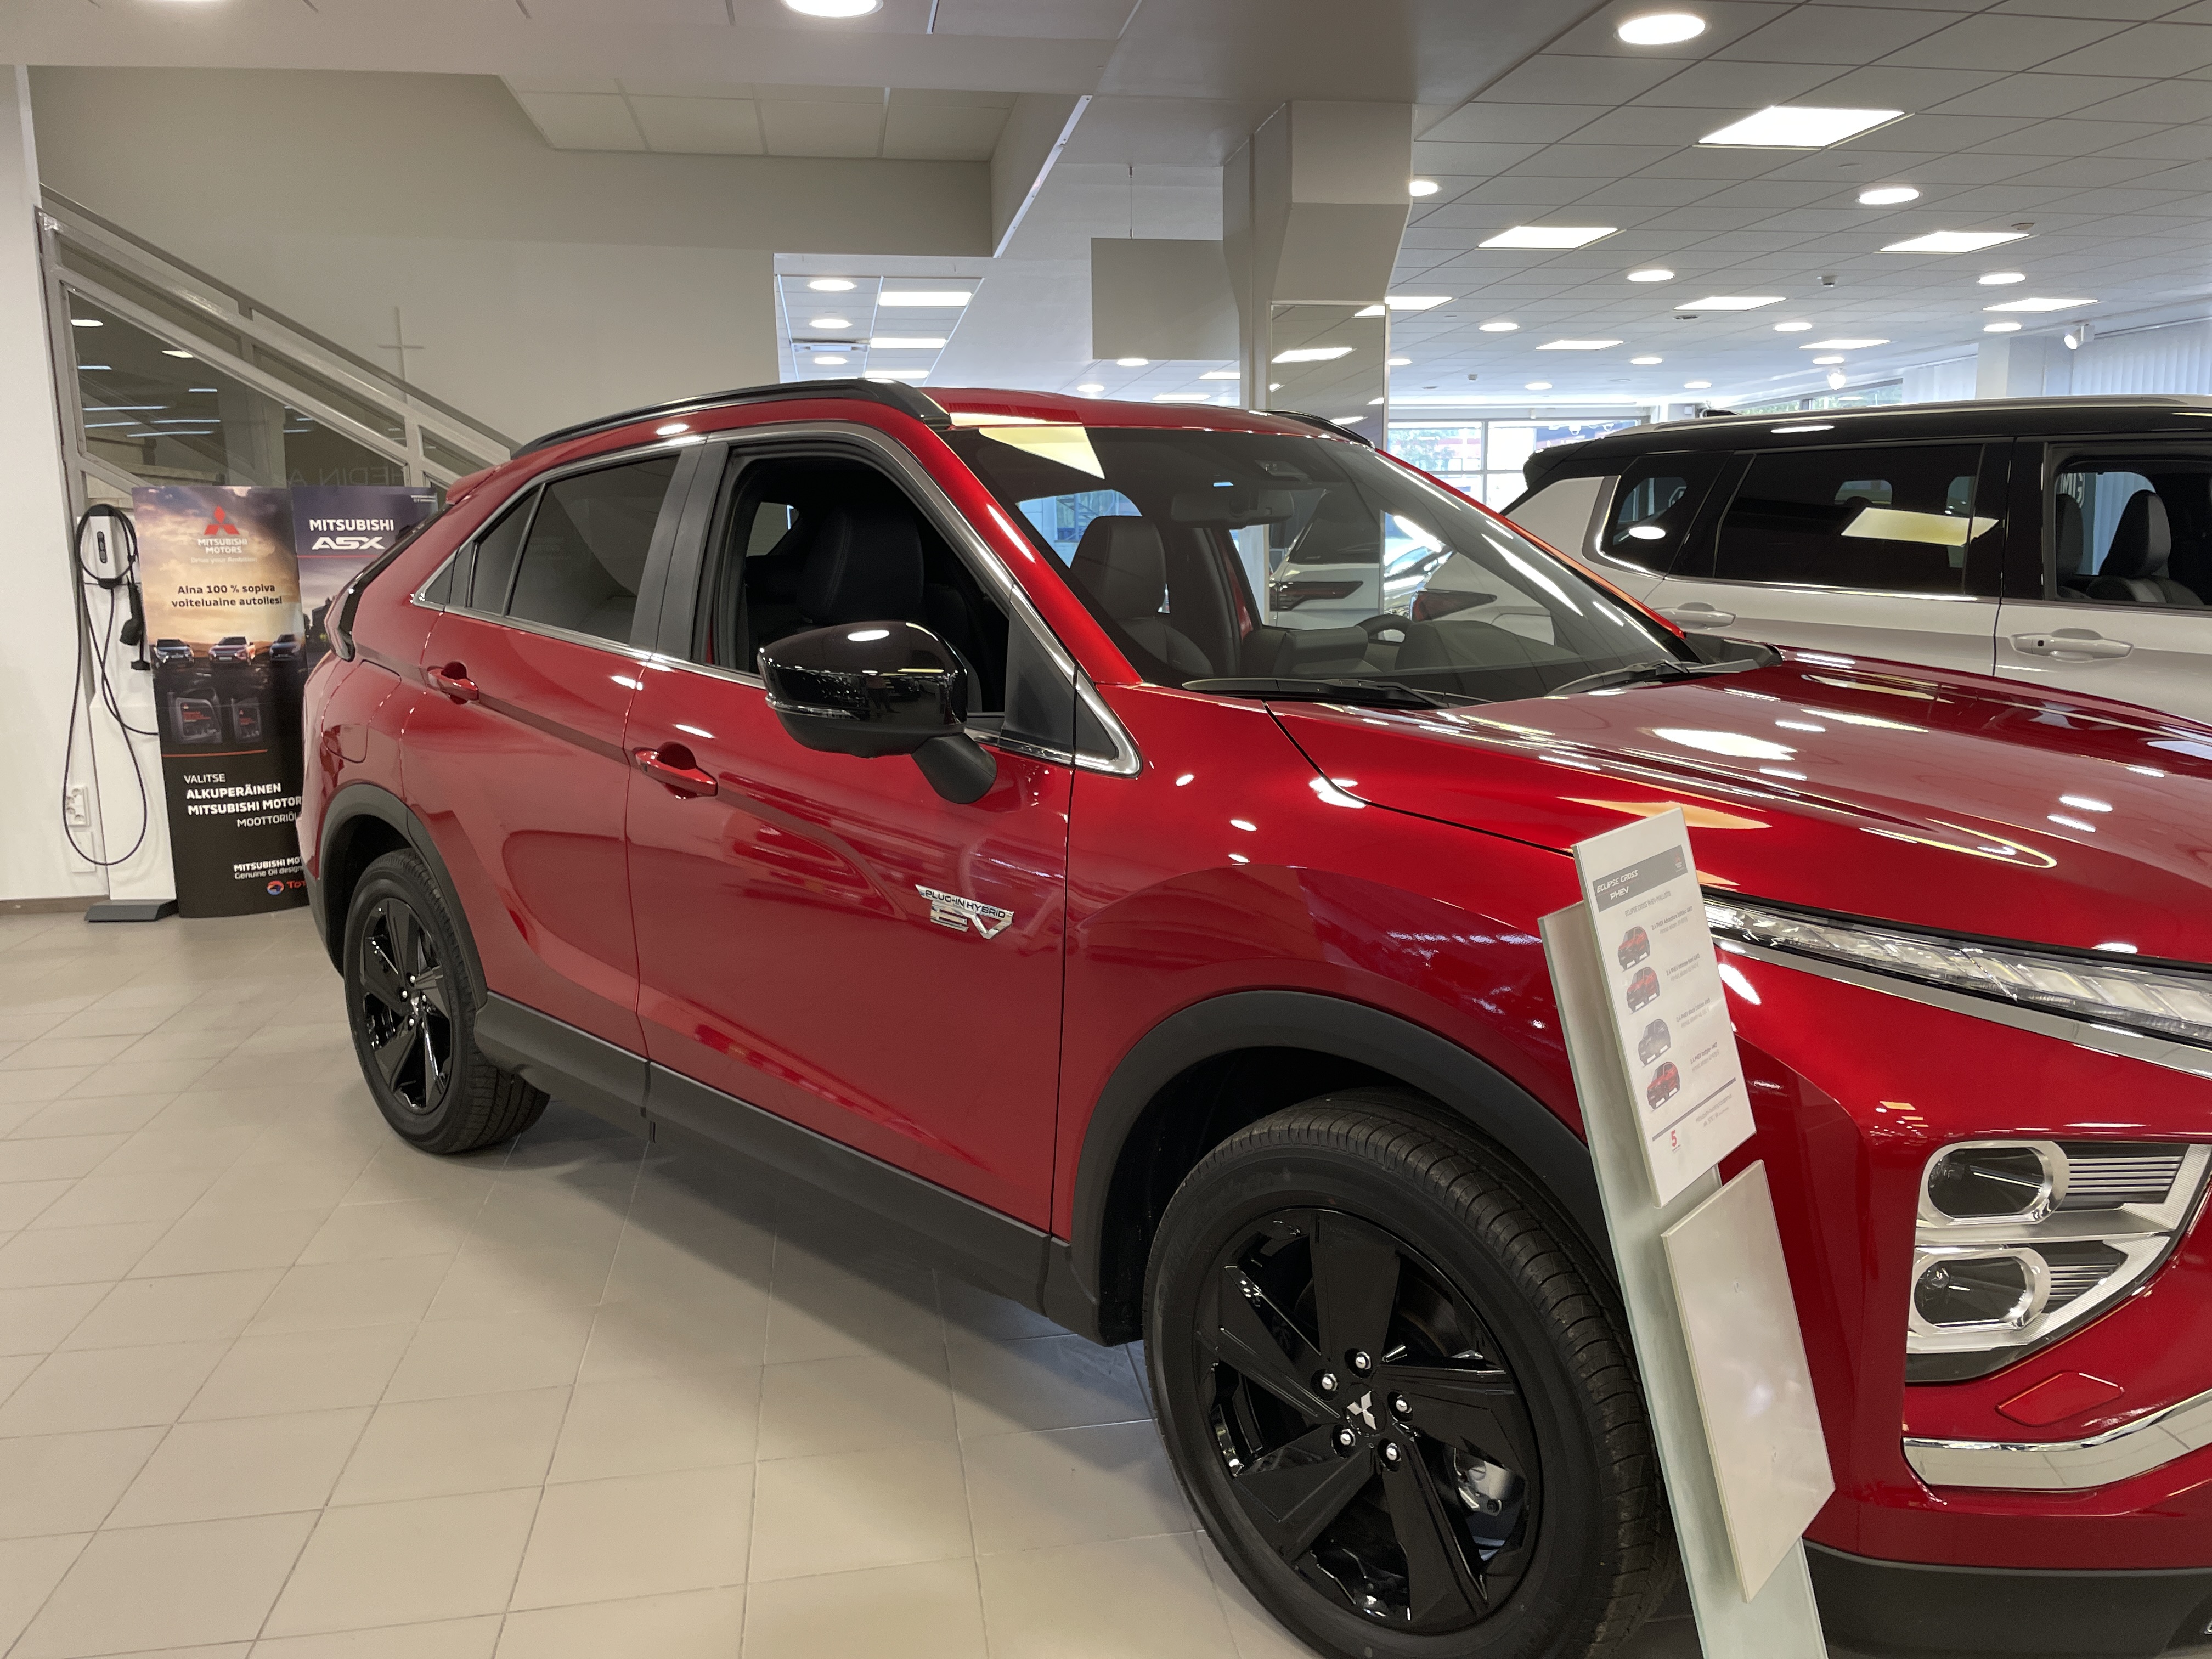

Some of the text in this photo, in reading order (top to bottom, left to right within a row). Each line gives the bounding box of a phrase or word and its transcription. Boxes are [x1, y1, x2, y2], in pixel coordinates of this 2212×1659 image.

[309, 519, 394, 531] MITSUBISHI
[312, 536, 386, 550] ASX
[178, 584, 275, 594] Aina 100 % sopiva
[171, 596, 283, 607] voiteluaine autollesi
[183, 773, 226, 784] VALITSE
[186, 783, 281, 799] ALKUPERÄINEN
[188, 801, 259, 816] MITSUBISHI
[233, 859, 286, 872] MITSUBISHI
[234, 870, 267, 880] Genuine
[268, 868, 278, 876] Oil
[1596, 870, 1639, 893] ECLIPSE CROSS
[1610, 885, 1629, 900] PHEV
[924, 889, 1006, 918] PLUG-IN HYBRID
[930, 900, 1013, 940] EV
[1671, 1130, 1677, 1147] 5
